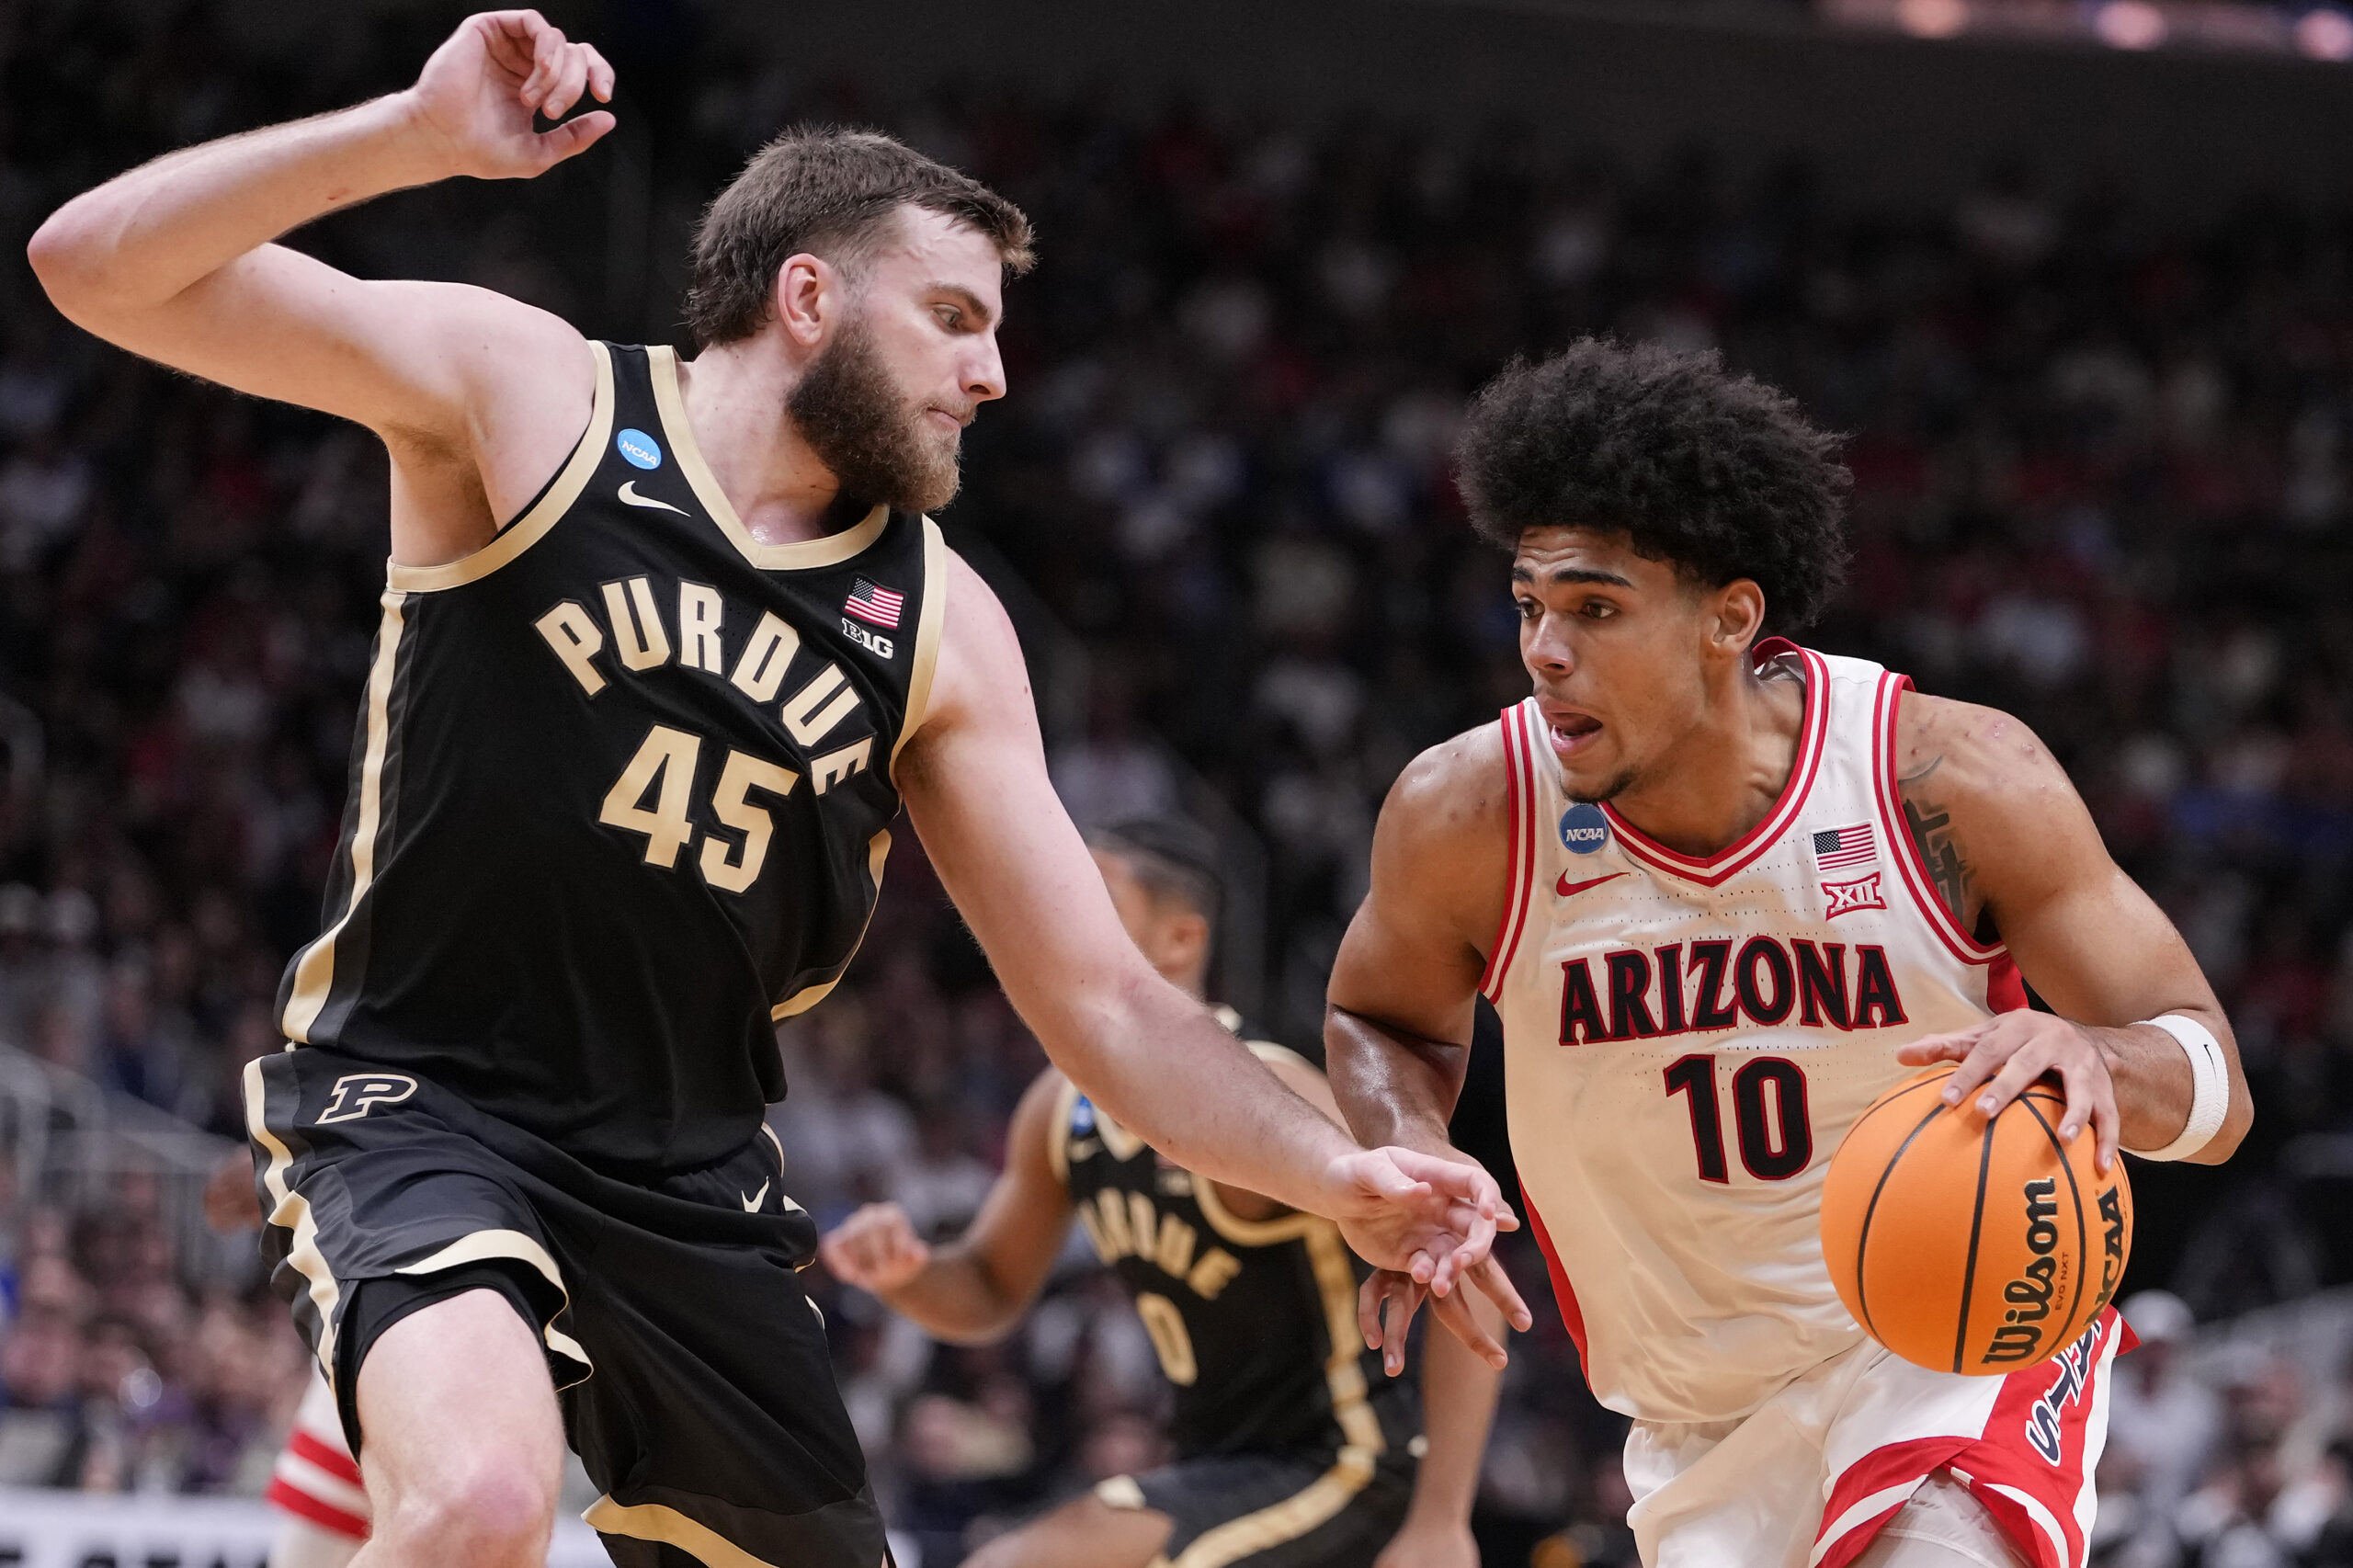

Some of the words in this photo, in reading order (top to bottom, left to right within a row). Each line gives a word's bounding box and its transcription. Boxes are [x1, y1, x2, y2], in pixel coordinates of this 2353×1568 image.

[621, 440, 658, 466] NCAA
[530, 574, 878, 797] PURDUE
[597, 720, 802, 896] 45
[1565, 827, 1605, 842] NCAA
[1559, 936, 1909, 1046] ARIZONA
[314, 1074, 418, 1124] P
[1664, 1054, 1813, 1184] 10
[1980, 1176, 2058, 1365] Wilson
[2054, 1283, 2066, 1312] EVO
[2060, 1251, 2070, 1281] NXT
